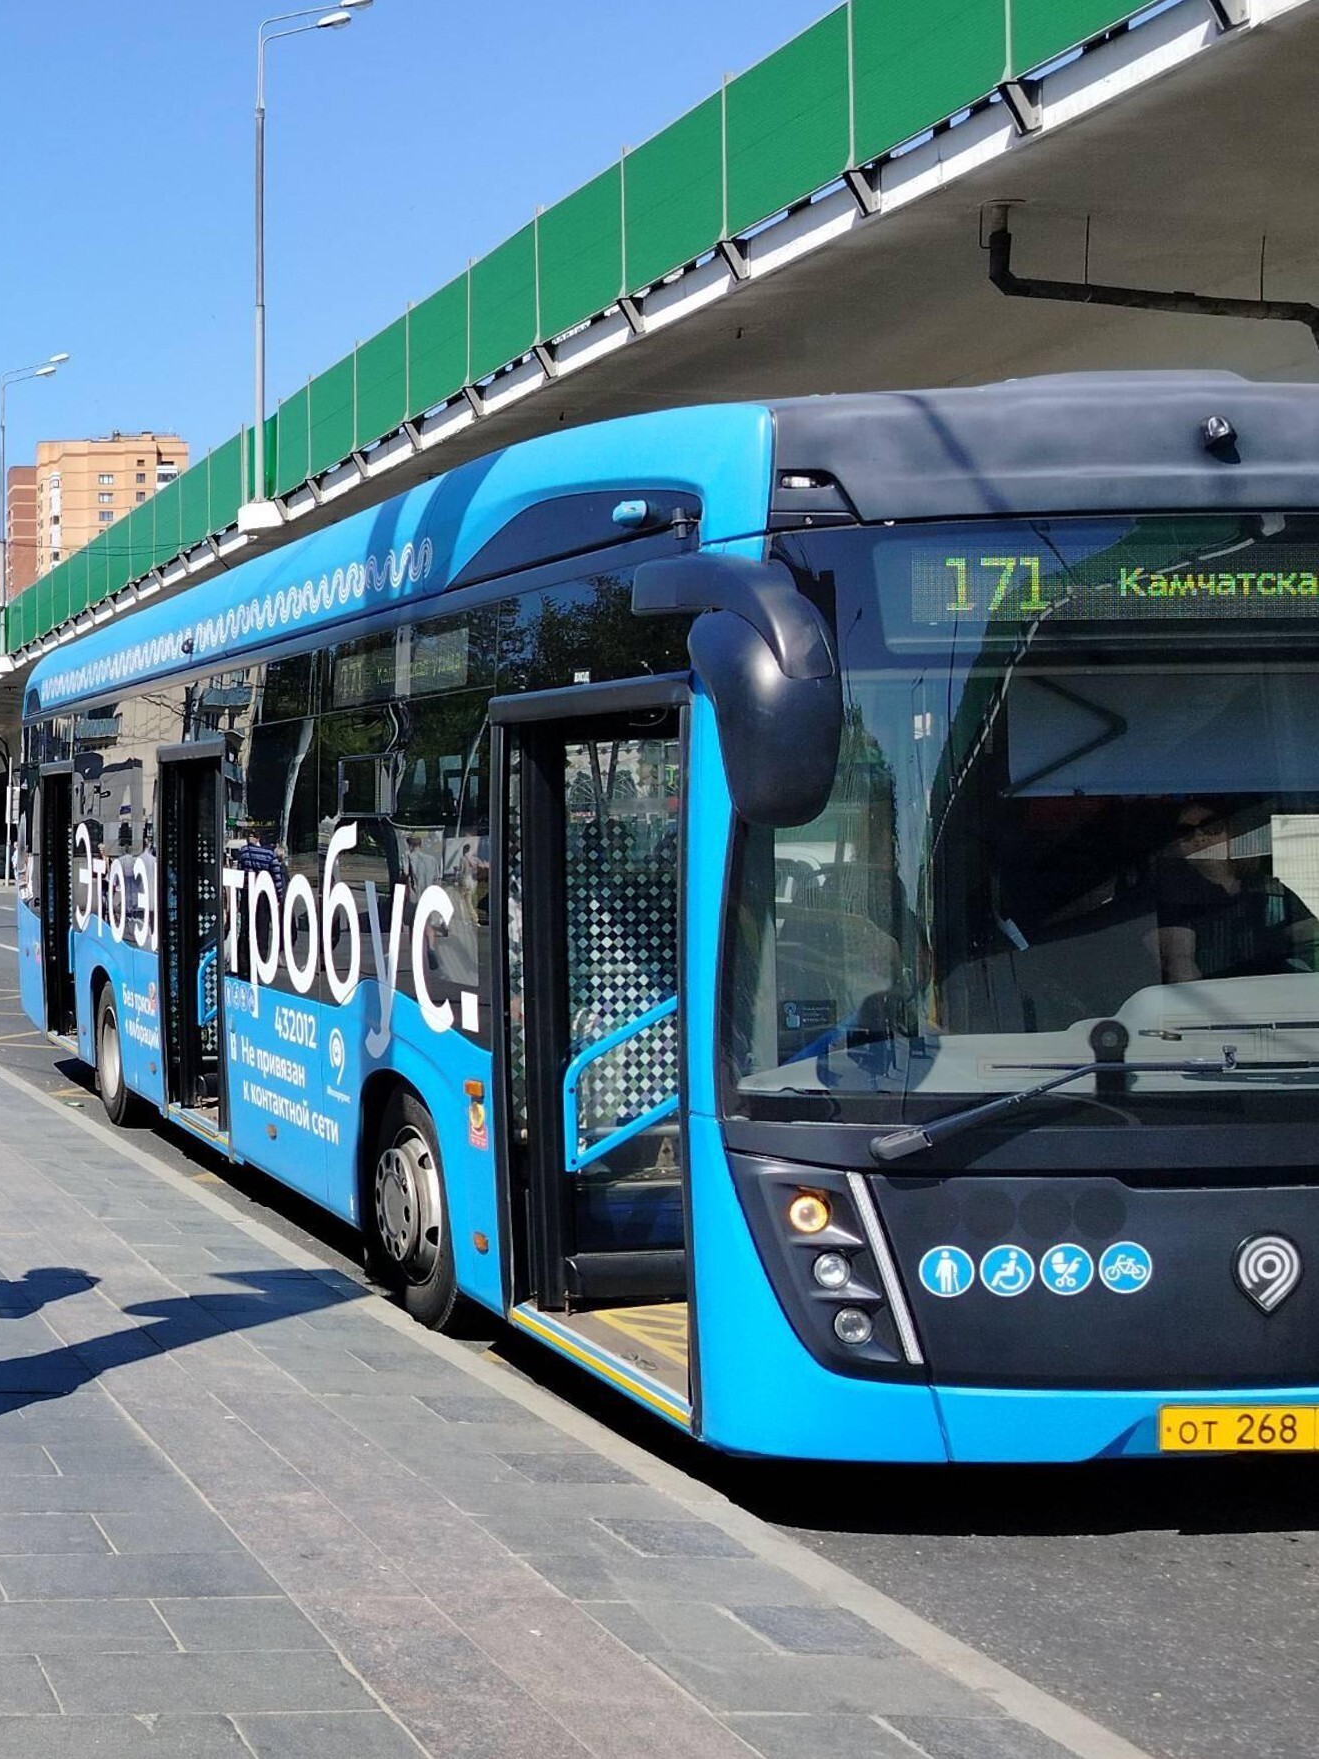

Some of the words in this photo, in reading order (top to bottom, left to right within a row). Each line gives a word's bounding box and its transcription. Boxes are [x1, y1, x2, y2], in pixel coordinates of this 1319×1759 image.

[944, 556, 1049, 611] 171
[74, 822, 126, 944] Это
[274, 1006, 317, 1050] 432012
[240, 1036, 256, 1067] Не
[257, 1048, 306, 1089] привязан
[243, 1079, 250, 1101] к
[251, 1084, 311, 1132] контактной
[312, 1111, 340, 1146] сети
[1178, 1420, 1219, 1445] ОТ
[1236, 1413, 1298, 1445] 268
